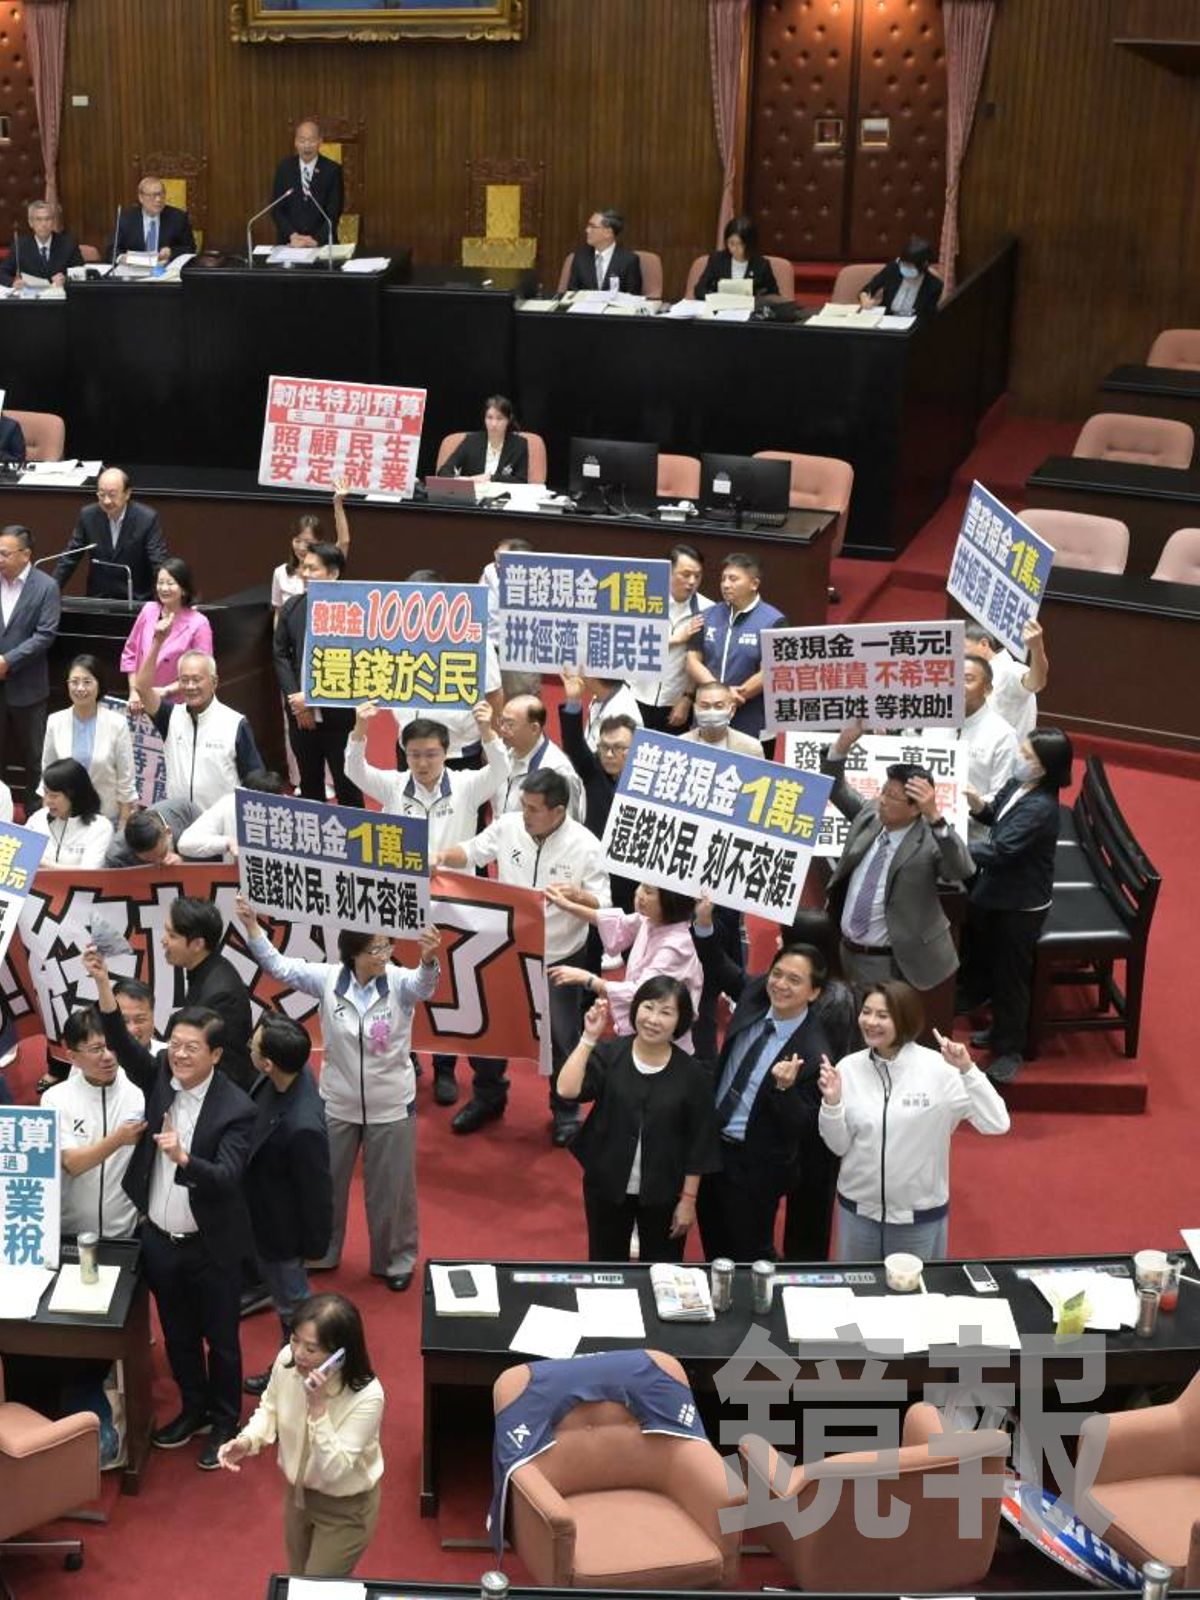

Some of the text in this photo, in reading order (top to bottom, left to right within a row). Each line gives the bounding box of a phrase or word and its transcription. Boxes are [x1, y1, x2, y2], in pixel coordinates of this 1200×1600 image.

[273, 383, 422, 417] 韌性特別預算
[273, 425, 410, 462] 照顧民生
[271, 454, 408, 491] 安定就業
[505, 564, 663, 614] 普發現金1萬元
[587, 622, 662, 672] 顧民生
[772, 633, 854, 661] 發現金
[861, 630, 952, 656] 一萬元!
[311, 646, 478, 704] 還錢於民
[771, 659, 955, 692] 高官權貴 不希罕!
[775, 693, 952, 722] 基層百姓 等救助!
[795, 741, 868, 771] 發金
[627, 741, 816, 838] 普發現金1萬元
[243, 801, 423, 871] 普發現金1萬元
[606, 803, 797, 909] 還錢於民! 刻不容緩!
[245, 854, 426, 931] 還錢於民! 刻不容緩!
